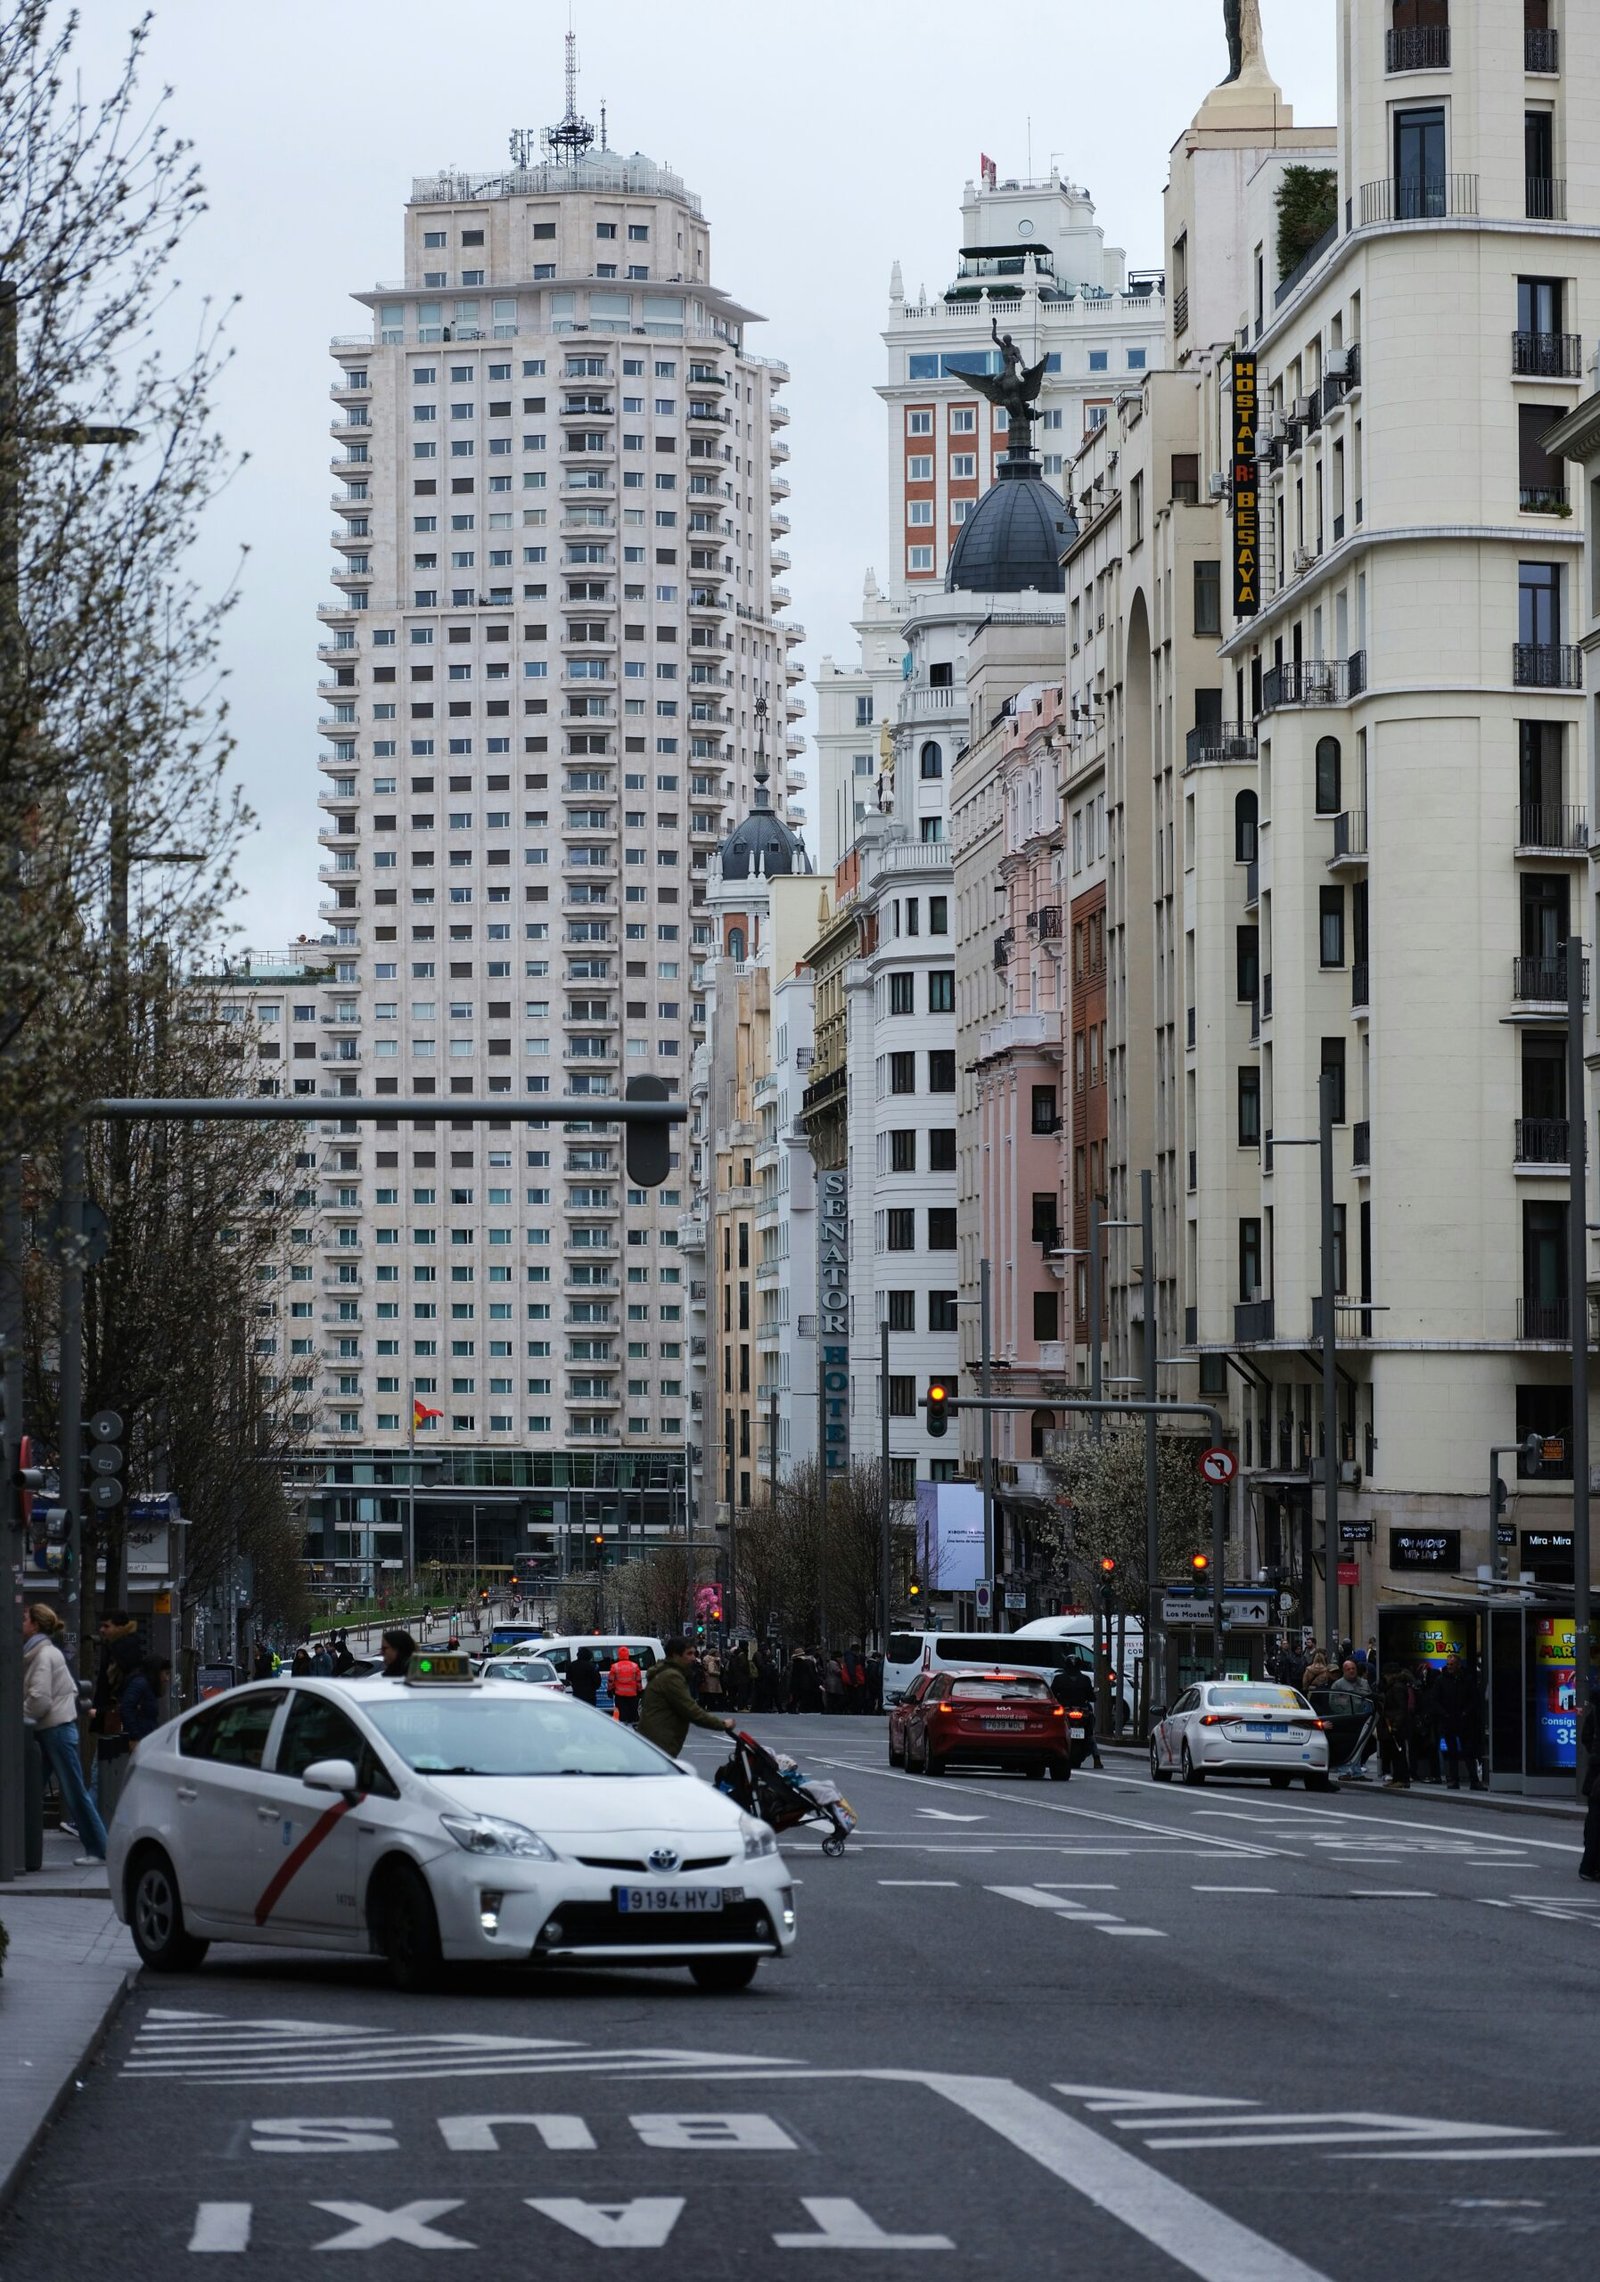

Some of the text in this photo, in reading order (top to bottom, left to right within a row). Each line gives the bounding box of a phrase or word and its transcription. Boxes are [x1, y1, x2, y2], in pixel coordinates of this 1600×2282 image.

[1236, 363, 1254, 455] HOSTAL
[1237, 492, 1256, 603] BESAYA
[821, 1175, 849, 1469] SENATOR HOTEL
[1435, 1641, 1462, 1653] DAY
[631, 1890, 721, 1910] 9194 HYJ
[248, 2112, 799, 2152] BUS
[187, 2197, 957, 2252] TAXI
